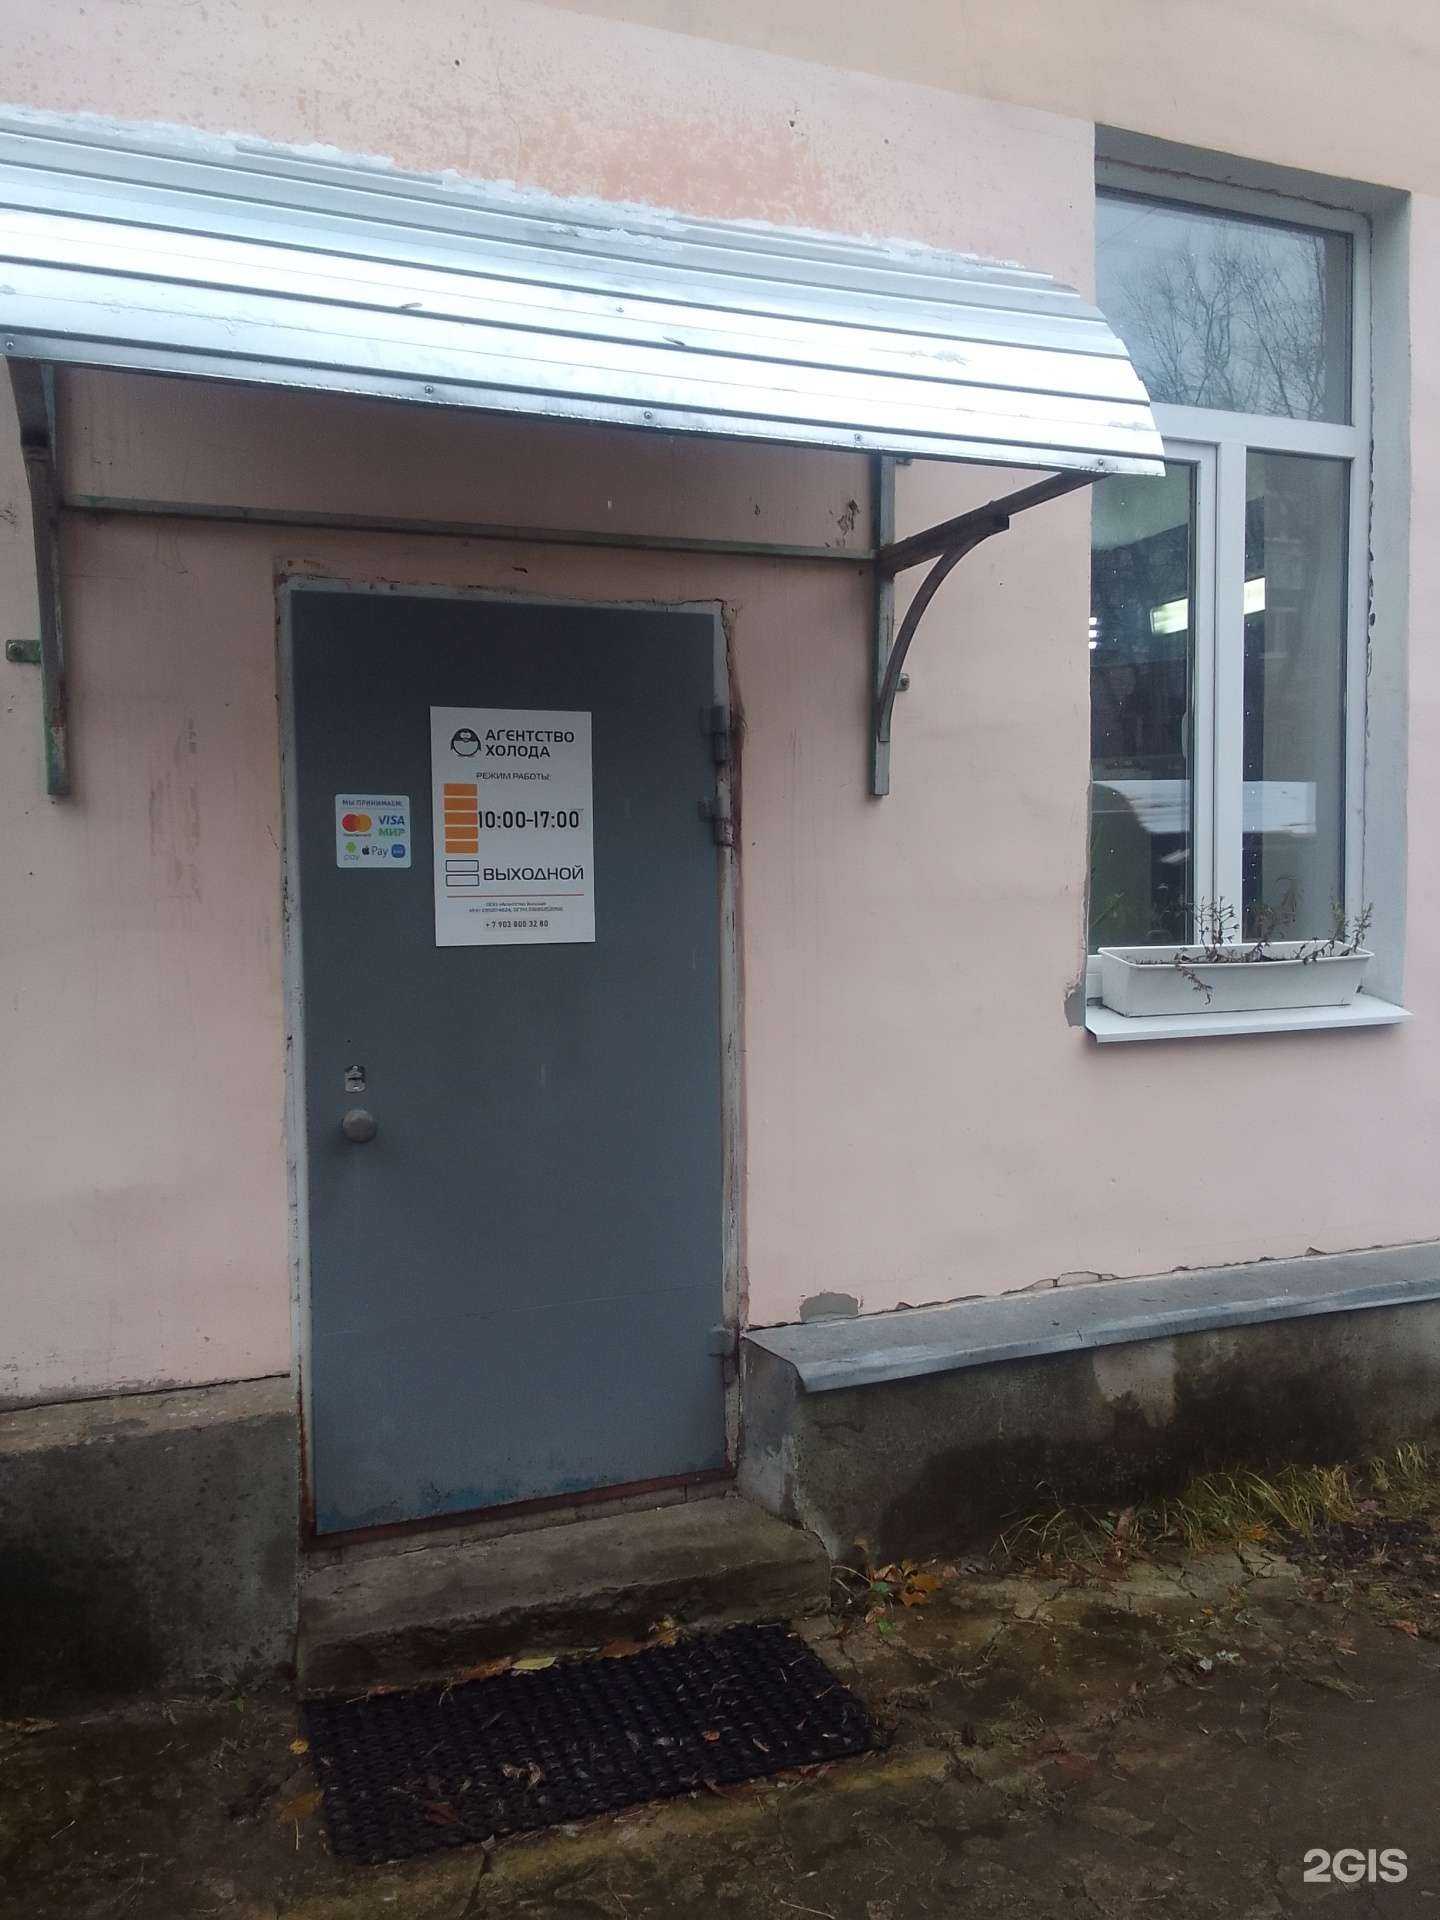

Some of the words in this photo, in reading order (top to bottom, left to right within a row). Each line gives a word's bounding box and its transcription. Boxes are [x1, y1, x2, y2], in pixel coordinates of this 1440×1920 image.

[485, 744, 551, 759] ХОЛОДА
[476, 771, 511, 781] РЕЖИМ
[378, 815, 405, 826] VISA
[478, 810, 579, 829] 10:00-17:00
[371, 846, 389, 859] Pay
[483, 864, 585, 882] ВЫХОДНОЙ
